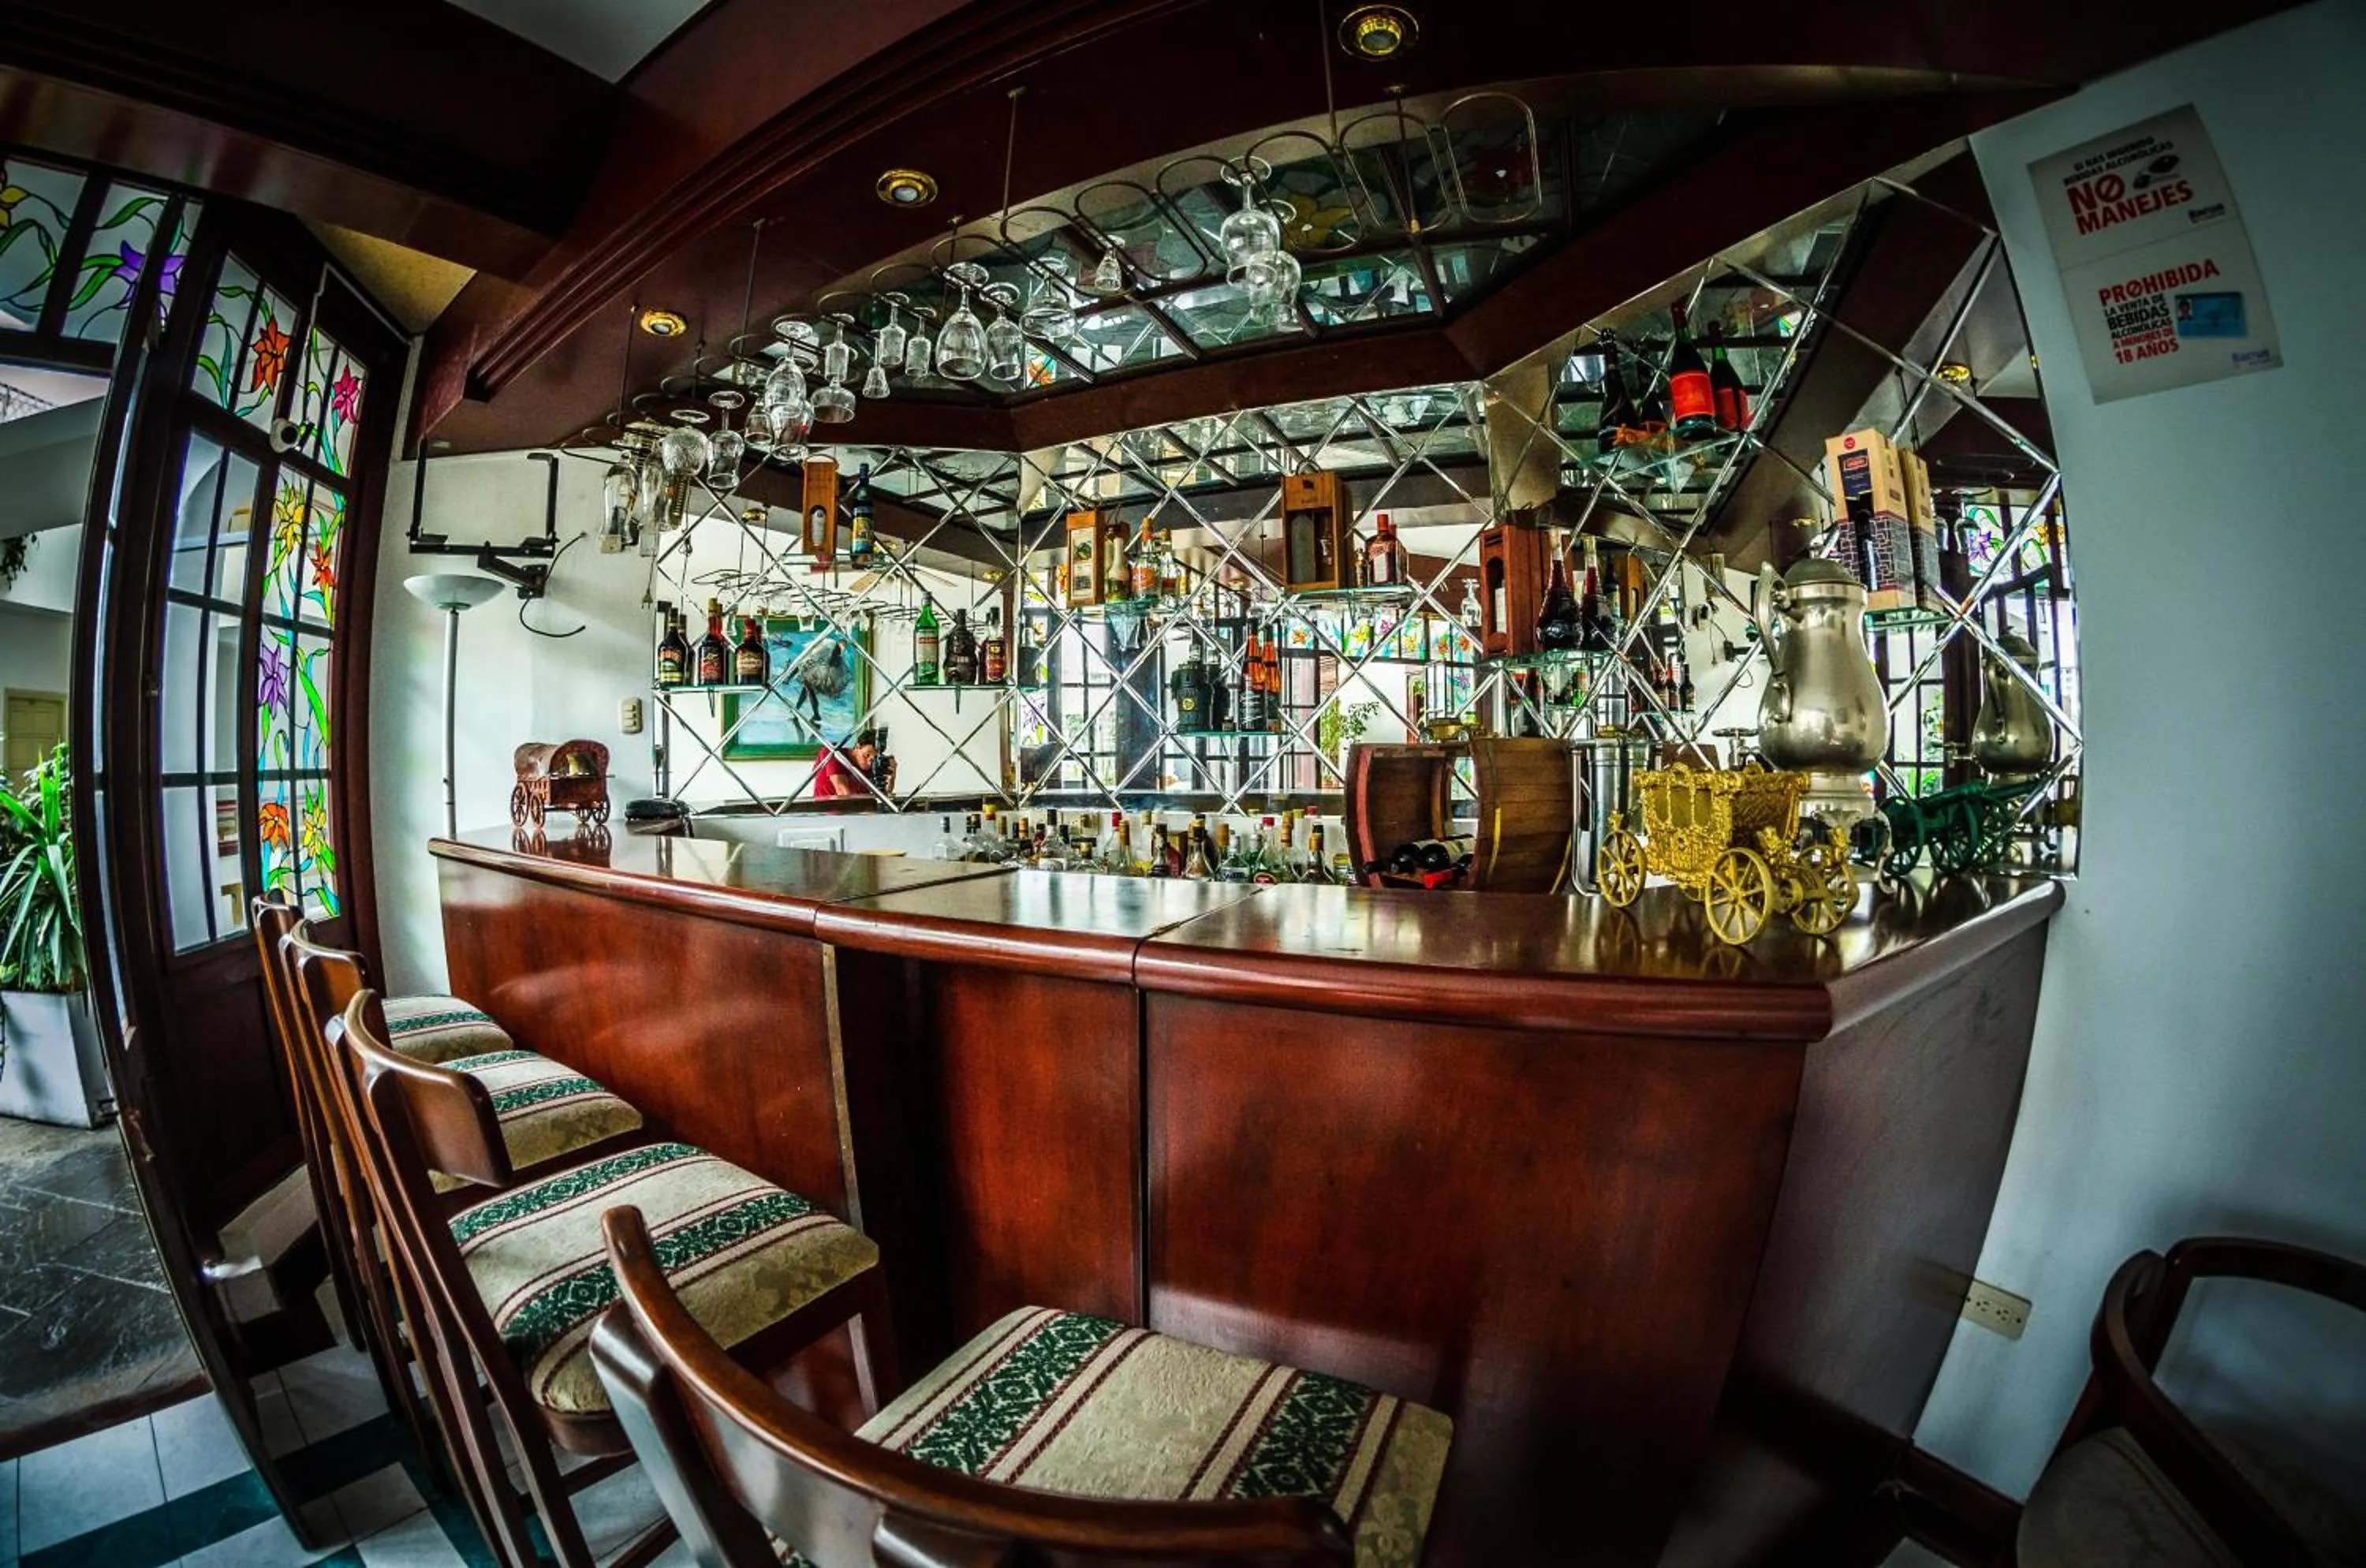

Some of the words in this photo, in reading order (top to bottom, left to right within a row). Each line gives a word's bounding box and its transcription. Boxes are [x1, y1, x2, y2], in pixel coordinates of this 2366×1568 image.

[2067, 173, 2125, 215] NO
[2076, 180, 2193, 235] MANEJES
[2099, 259, 2220, 305] PROHIBIDA
[2104, 306, 2118, 317] LA
[2107, 304, 2170, 330] BEBIDAS
[2115, 348, 2133, 364] 18
